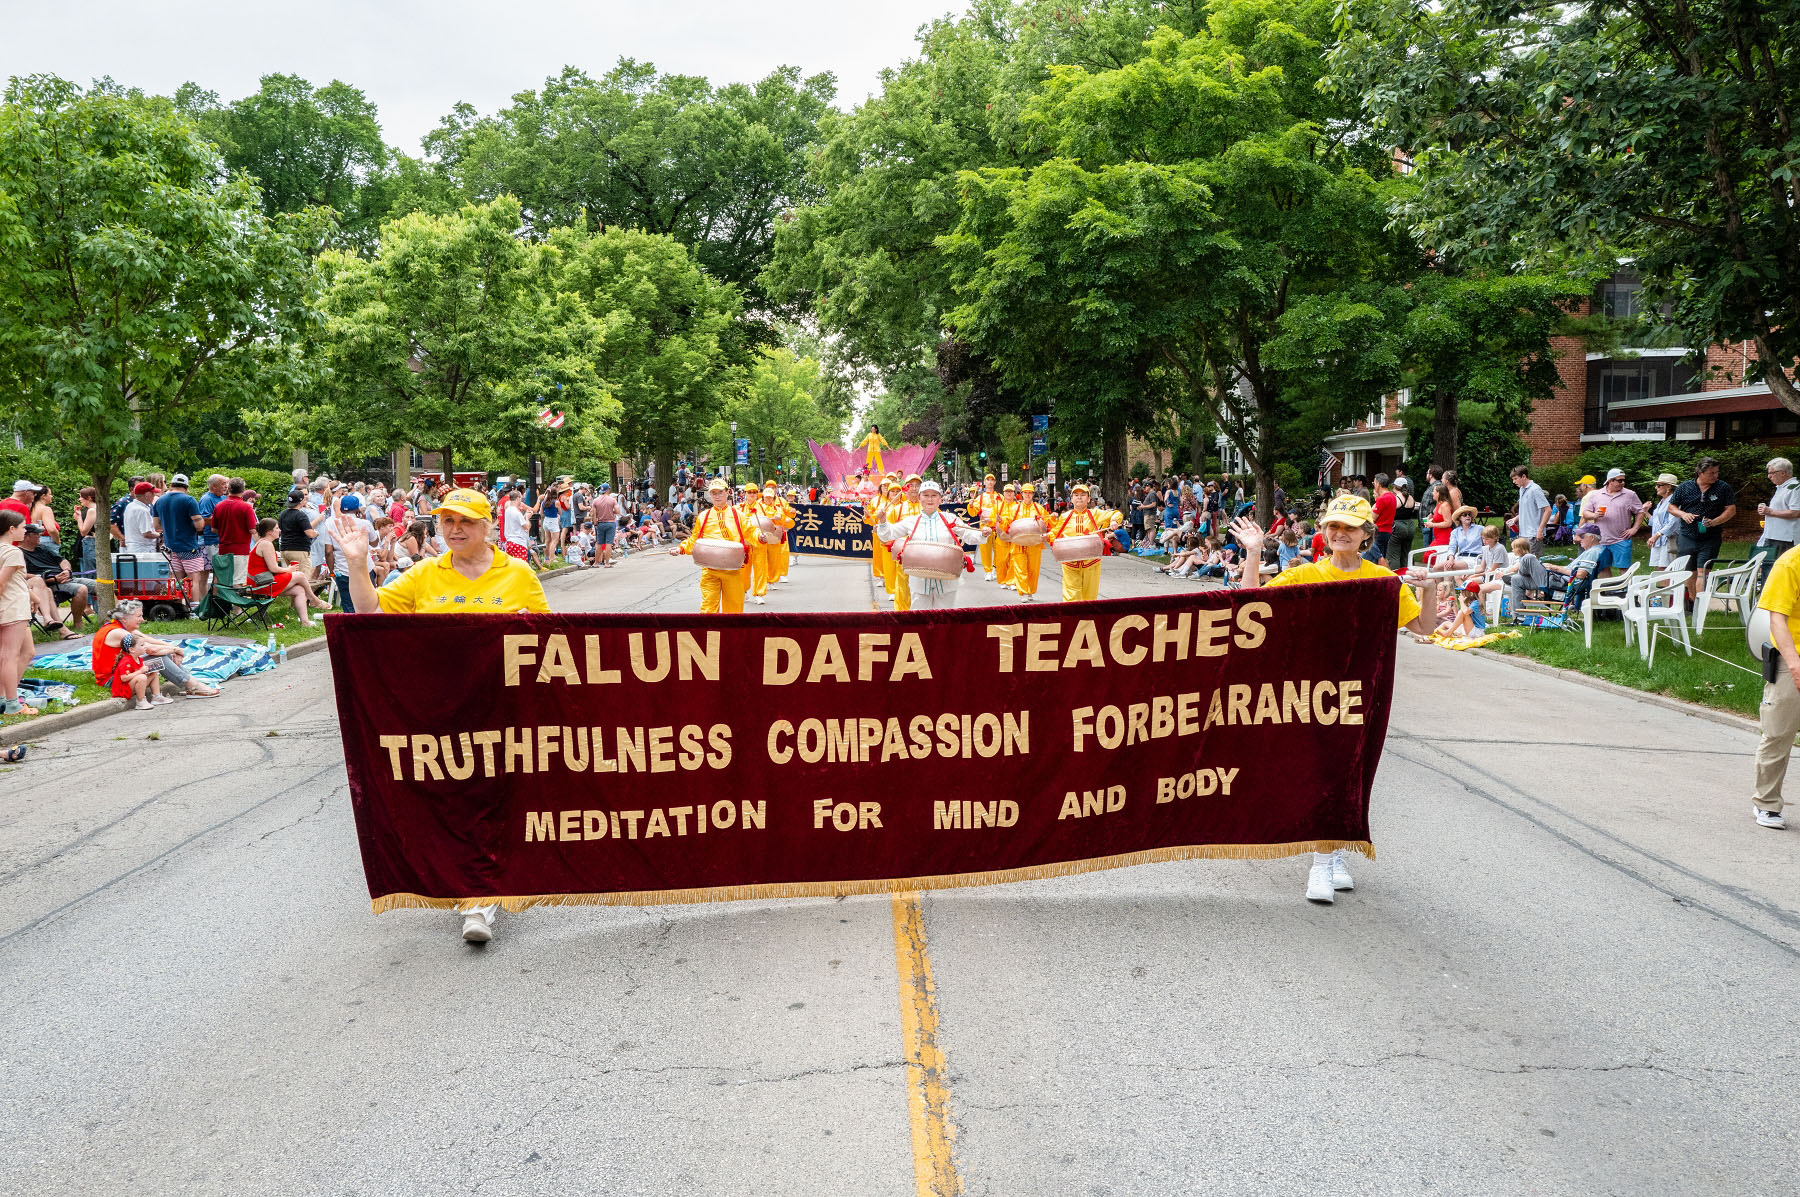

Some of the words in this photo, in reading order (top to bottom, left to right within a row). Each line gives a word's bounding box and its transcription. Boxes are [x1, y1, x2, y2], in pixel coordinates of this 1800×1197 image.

[795, 508, 862, 534] 法輪
[795, 535, 846, 551] FALUN
[503, 630, 721, 687] FALUN
[763, 632, 933, 686] DAFA
[986, 602, 1274, 673] TEACHES
[379, 723, 733, 782] TRUTHFULNESS
[766, 708, 1031, 766] COMPASSION
[1071, 678, 1365, 754] FORBEARANCE
[524, 799, 768, 843] MEDITATION
[812, 798, 884, 832] FOR
[932, 799, 1020, 831] MIND
[1057, 784, 1128, 821] AND
[1156, 765, 1240, 804] BODY
